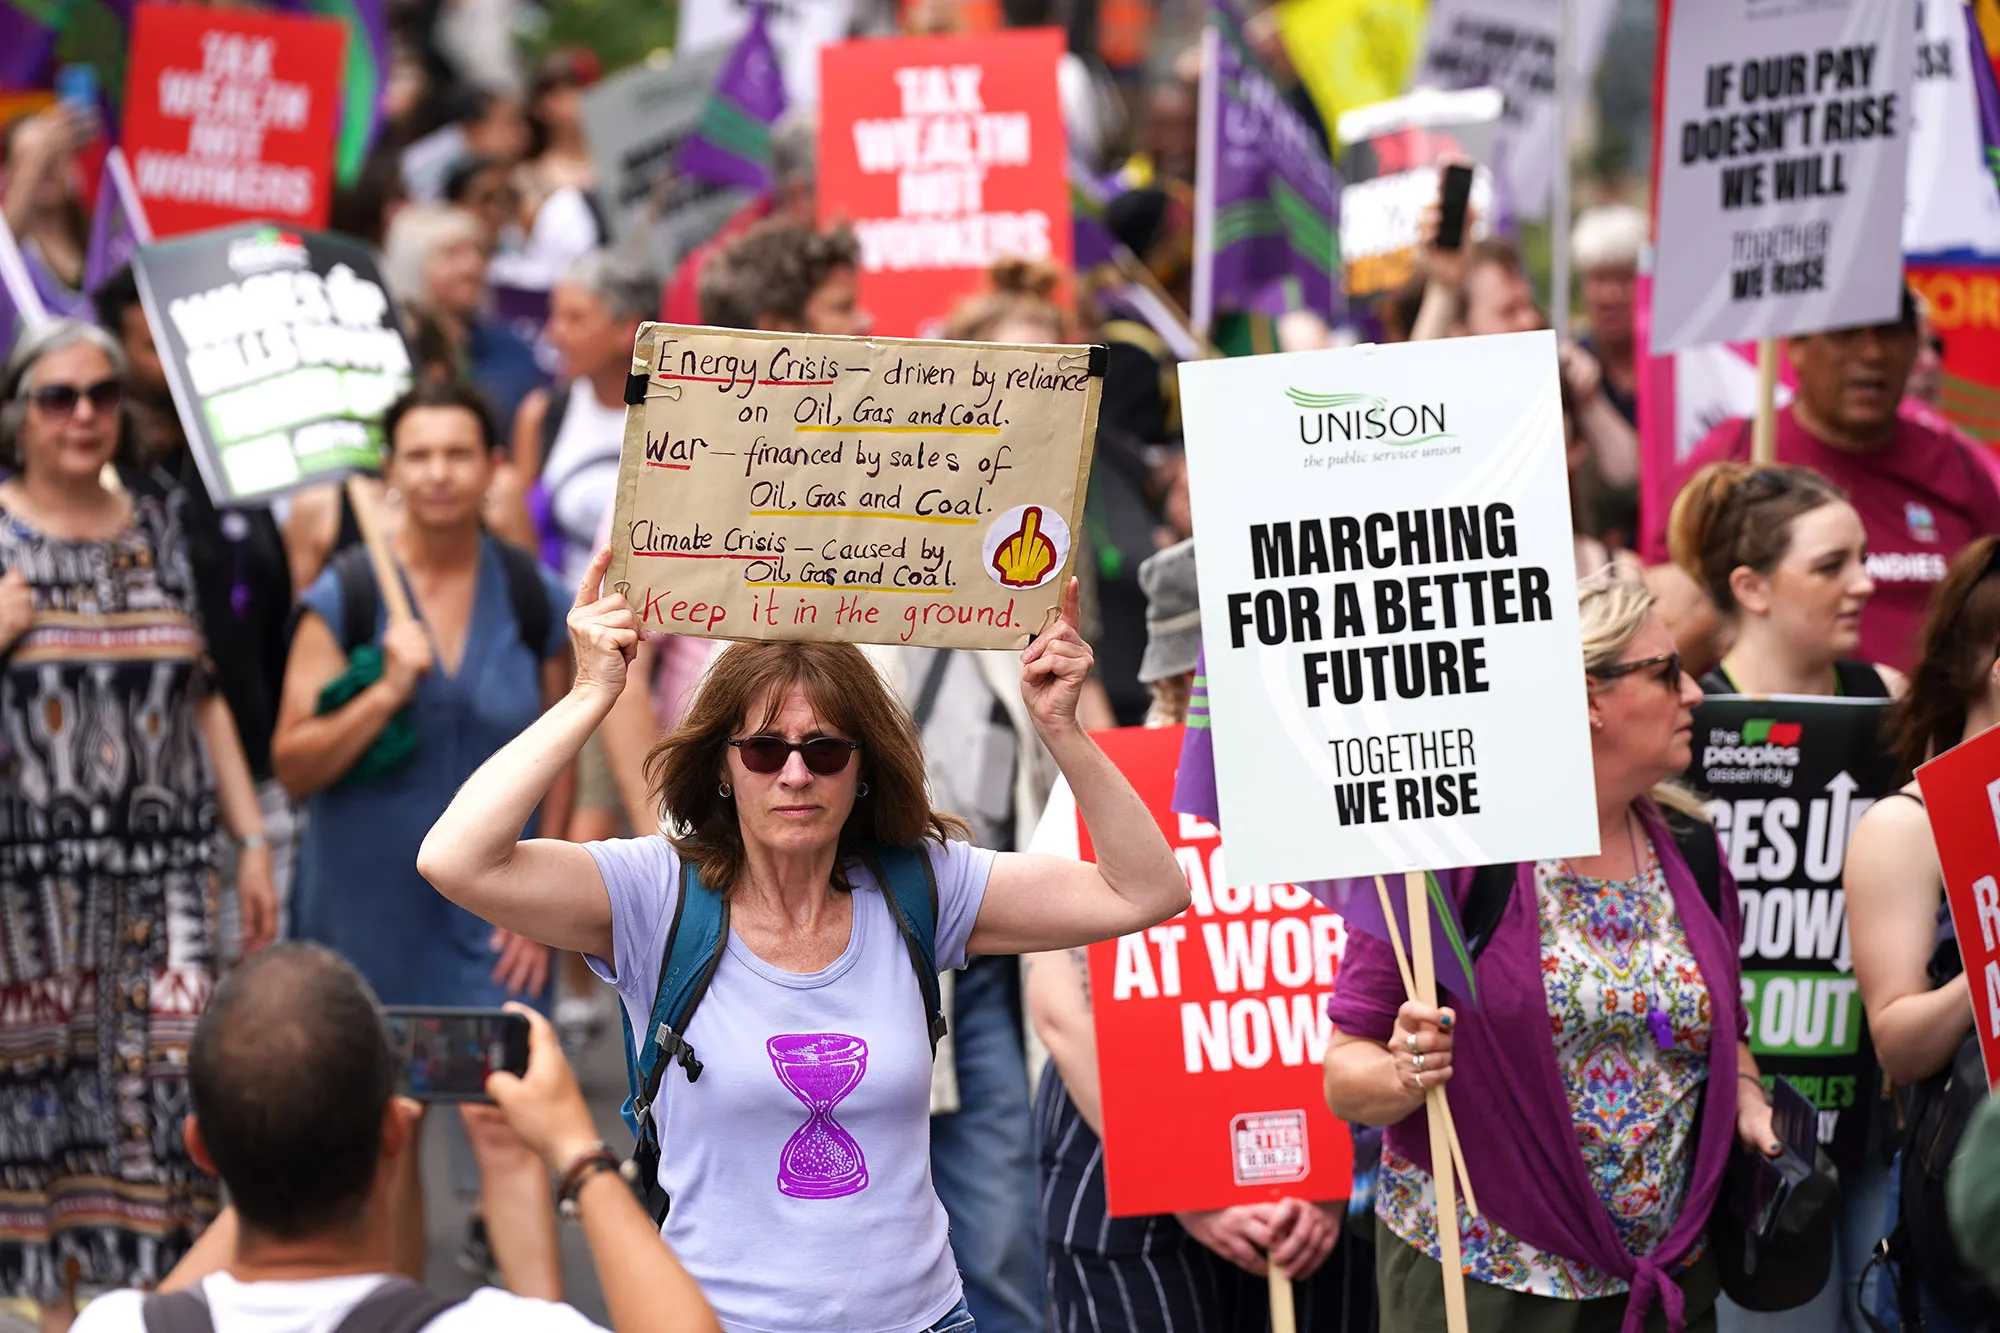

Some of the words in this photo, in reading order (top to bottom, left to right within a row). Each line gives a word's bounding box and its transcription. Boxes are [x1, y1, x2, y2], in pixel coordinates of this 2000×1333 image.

[1706, 64, 1734, 109] IF
[1741, 53, 1805, 105] OUR
[1814, 44, 1876, 92] PAY
[1681, 103, 1816, 166] DOESN'T
[1824, 92, 1897, 143] RISE
[1721, 162, 1765, 210] WE
[1774, 153, 1846, 202] WILL
[1732, 266, 1763, 302] WE
[1772, 256, 1824, 294] RISE
[658, 340, 757, 399] Energy
[769, 347, 839, 381] Crisis
[884, 357, 955, 386] driven
[972, 360, 995, 408] by
[1006, 363, 1089, 391] reliance
[738, 406, 768, 423] on
[794, 393, 842, 426] Oil,
[853, 396, 894, 424] Gas
[908, 403, 946, 426] and
[950, 400, 1010, 426] Coal.
[1300, 403, 1445, 444] UNISON
[646, 431, 708, 462] War
[744, 436, 843, 477] financed
[856, 440, 880, 478] by
[890, 442, 959, 471] sales
[978, 445, 1012, 485] of
[1303, 454, 1324, 469] the
[1327, 450, 1367, 470] public
[1371, 446, 1418, 463] service
[1422, 444, 1462, 458] union
[750, 480, 797, 510] Oil,
[806, 484, 847, 507] Gas
[859, 484, 902, 509] and
[915, 487, 992, 516] Coal.
[630, 519, 713, 552] Climate
[724, 527, 787, 553] Crisis
[921, 537, 945, 572] by
[1250, 502, 1518, 580] MARCHING
[1865, 551, 1947, 582] NDIES
[744, 556, 791, 583] Oil,
[799, 562, 838, 586] Gas
[843, 562, 884, 585] and
[893, 560, 957, 586] Coal.
[642, 587, 727, 632] Keep
[752, 587, 780, 626] it
[793, 598, 817, 625] in
[835, 595, 879, 625] the
[900, 598, 1021, 642] ground.
[1227, 587, 1323, 649] FOR
[1333, 582, 1366, 639] A
[1373, 566, 1553, 635] BETTER
[1303, 638, 1490, 708] FUTURE
[1328, 728, 1476, 778] TOGETHER
[1709, 728, 1740, 746] the
[1333, 780, 1389, 827] WE
[1396, 772, 1481, 821] RISE
[1113, 925, 1187, 1001] AT
[1201, 913, 1349, 993] WOR
[1758, 977, 1858, 1048] OUT
